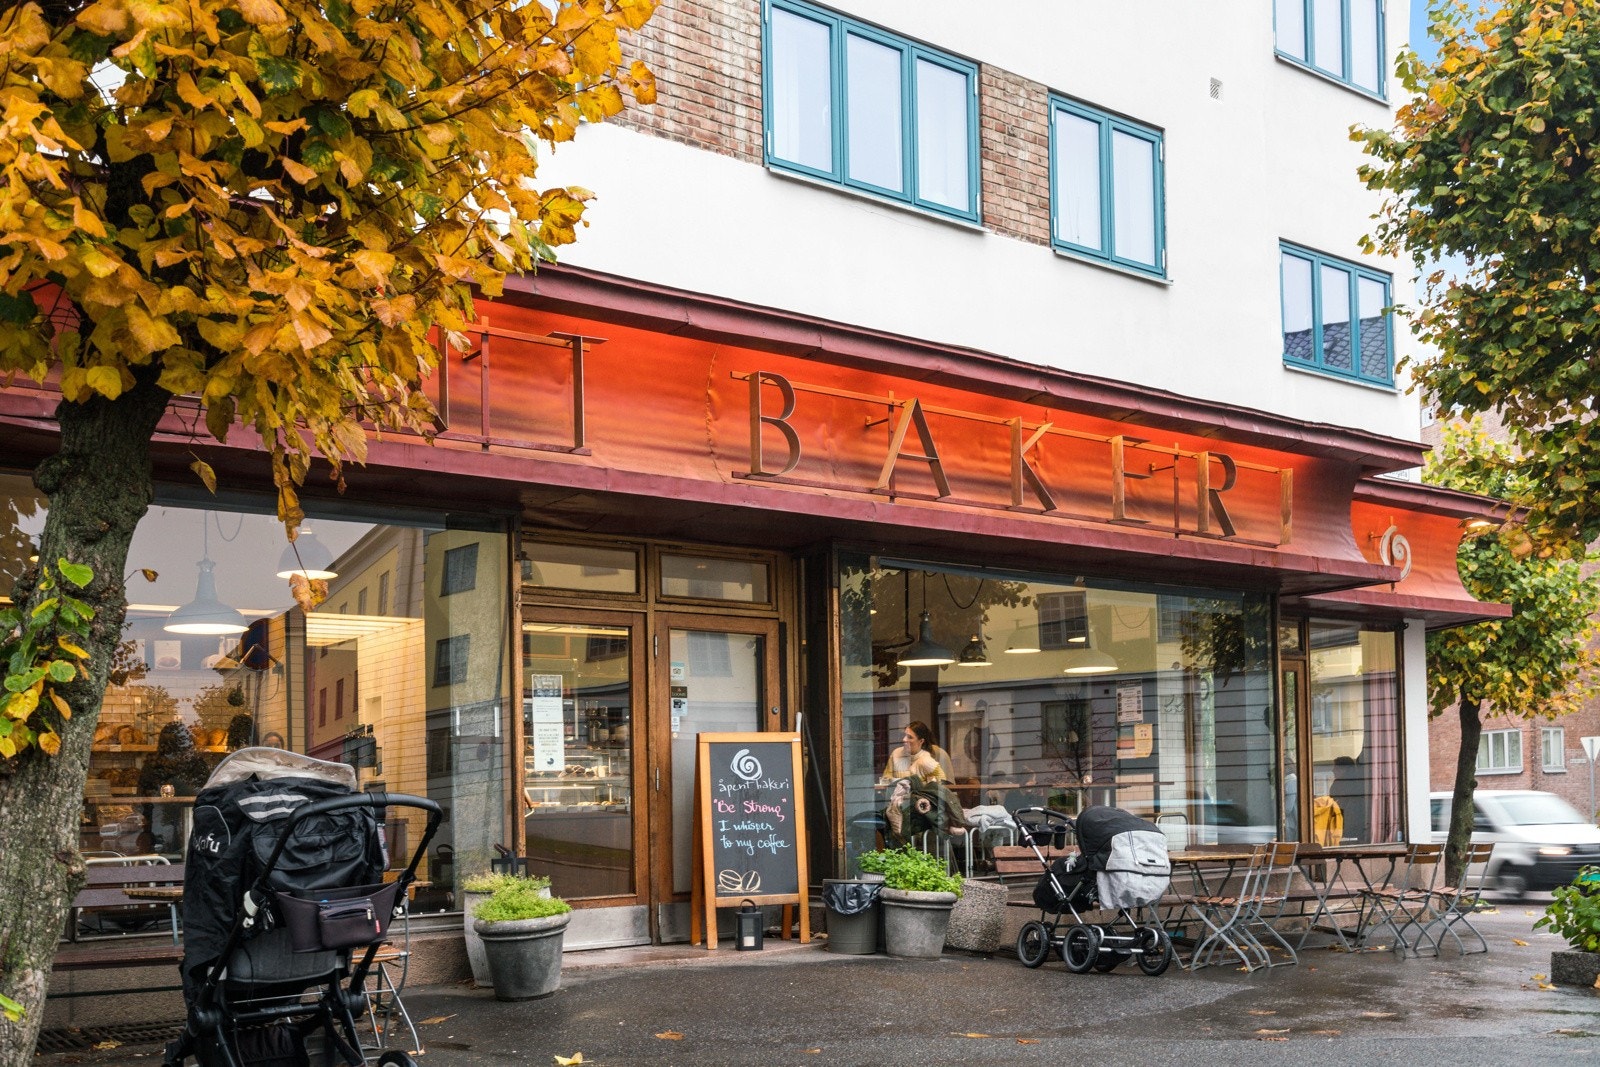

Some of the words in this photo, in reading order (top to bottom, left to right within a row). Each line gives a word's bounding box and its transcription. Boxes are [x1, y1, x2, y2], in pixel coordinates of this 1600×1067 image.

[749, 370, 1293, 545] BAKERI
[718, 778, 754, 797] åpent
[718, 819, 731, 832] I
[733, 820, 775, 833] whisper
[720, 834, 733, 849] to
[735, 839, 755, 856] my
[757, 833, 791, 855] coffee
